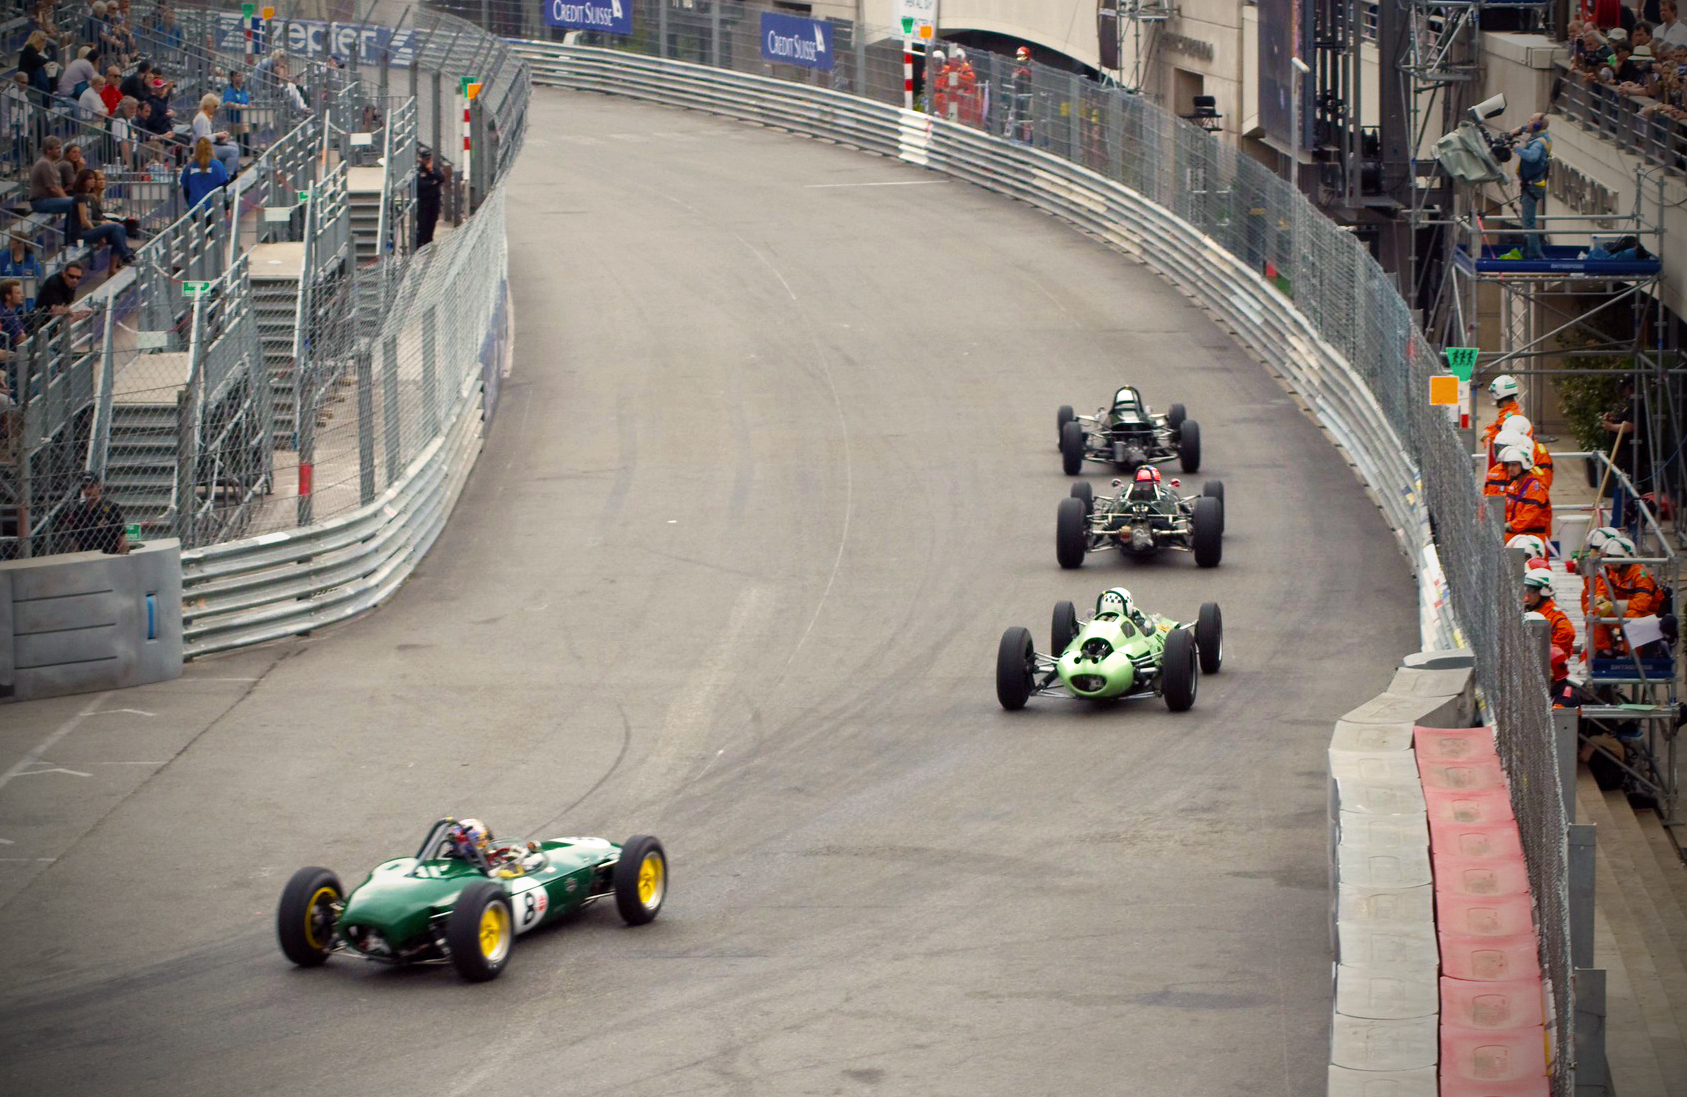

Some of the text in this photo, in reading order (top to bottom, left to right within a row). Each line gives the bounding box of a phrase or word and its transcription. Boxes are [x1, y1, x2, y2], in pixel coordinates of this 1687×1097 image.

[553, 0, 613, 26] CREDIT SUISSE
[768, 30, 817, 61] CREDIT SUISSE
[524, 891, 535, 926] 8
